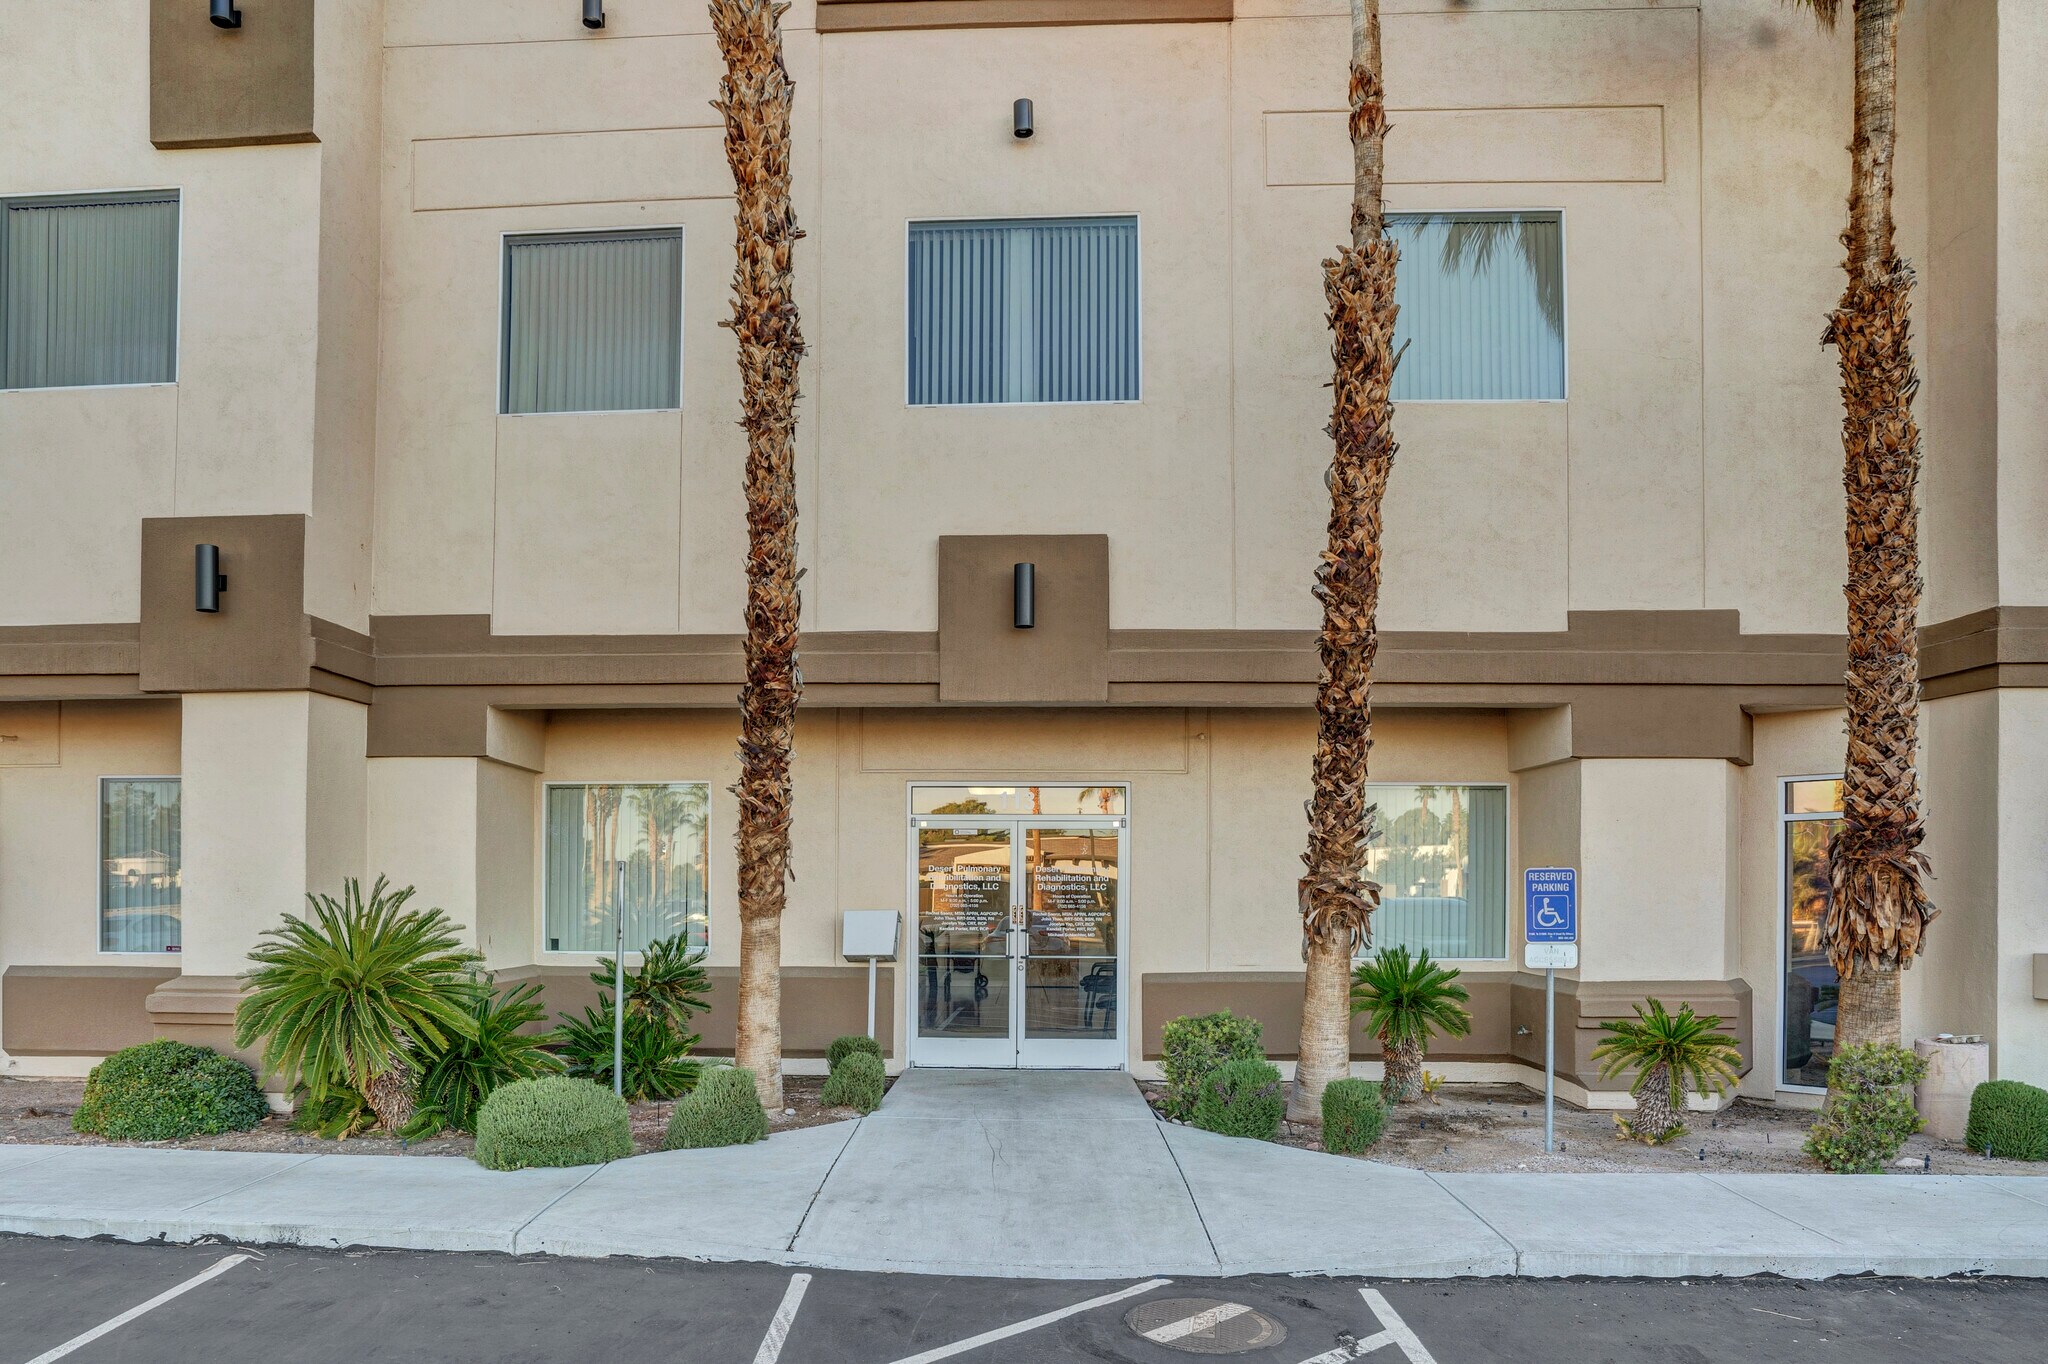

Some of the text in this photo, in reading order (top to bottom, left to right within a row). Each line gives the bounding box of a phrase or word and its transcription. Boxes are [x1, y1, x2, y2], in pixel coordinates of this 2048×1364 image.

[1000, 791, 1035, 810] 113
[957, 865, 1001, 874] Pulmonary
[1528, 872, 1573, 880] RESERVED
[930, 883, 981, 891] Dgnostics,
[1037, 884, 1088, 892] Diagnostics,
[1532, 883, 1569, 891] PARKING
